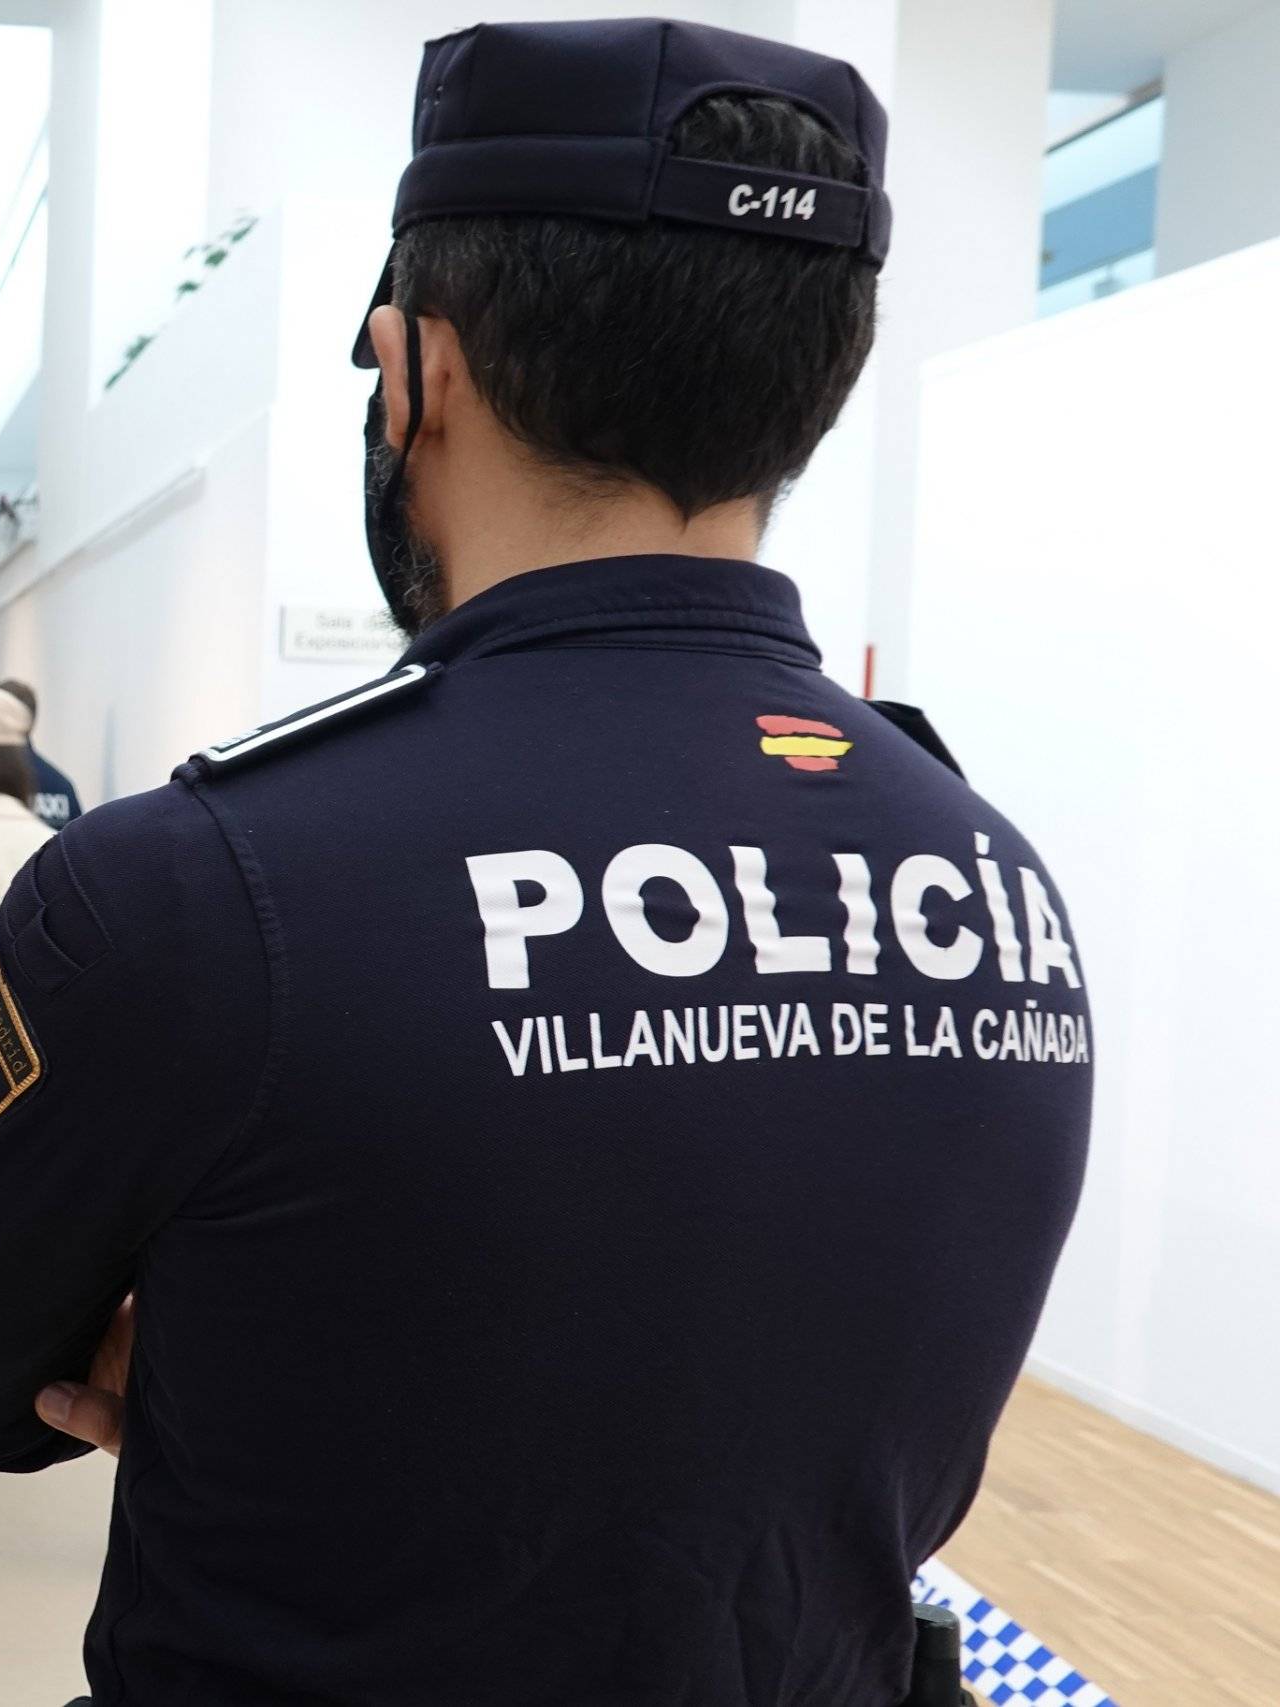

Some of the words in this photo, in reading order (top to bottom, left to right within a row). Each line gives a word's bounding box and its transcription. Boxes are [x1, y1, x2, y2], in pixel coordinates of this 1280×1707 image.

[728, 184, 817, 220] C-114
[465, 831, 1082, 990] POLICÍA
[492, 1003, 821, 1077] VILLANUEVA
[831, 1003, 890, 1057] DE
[904, 1004, 963, 1059] LA
[973, 1000, 1089, 1064] CAÑADA
